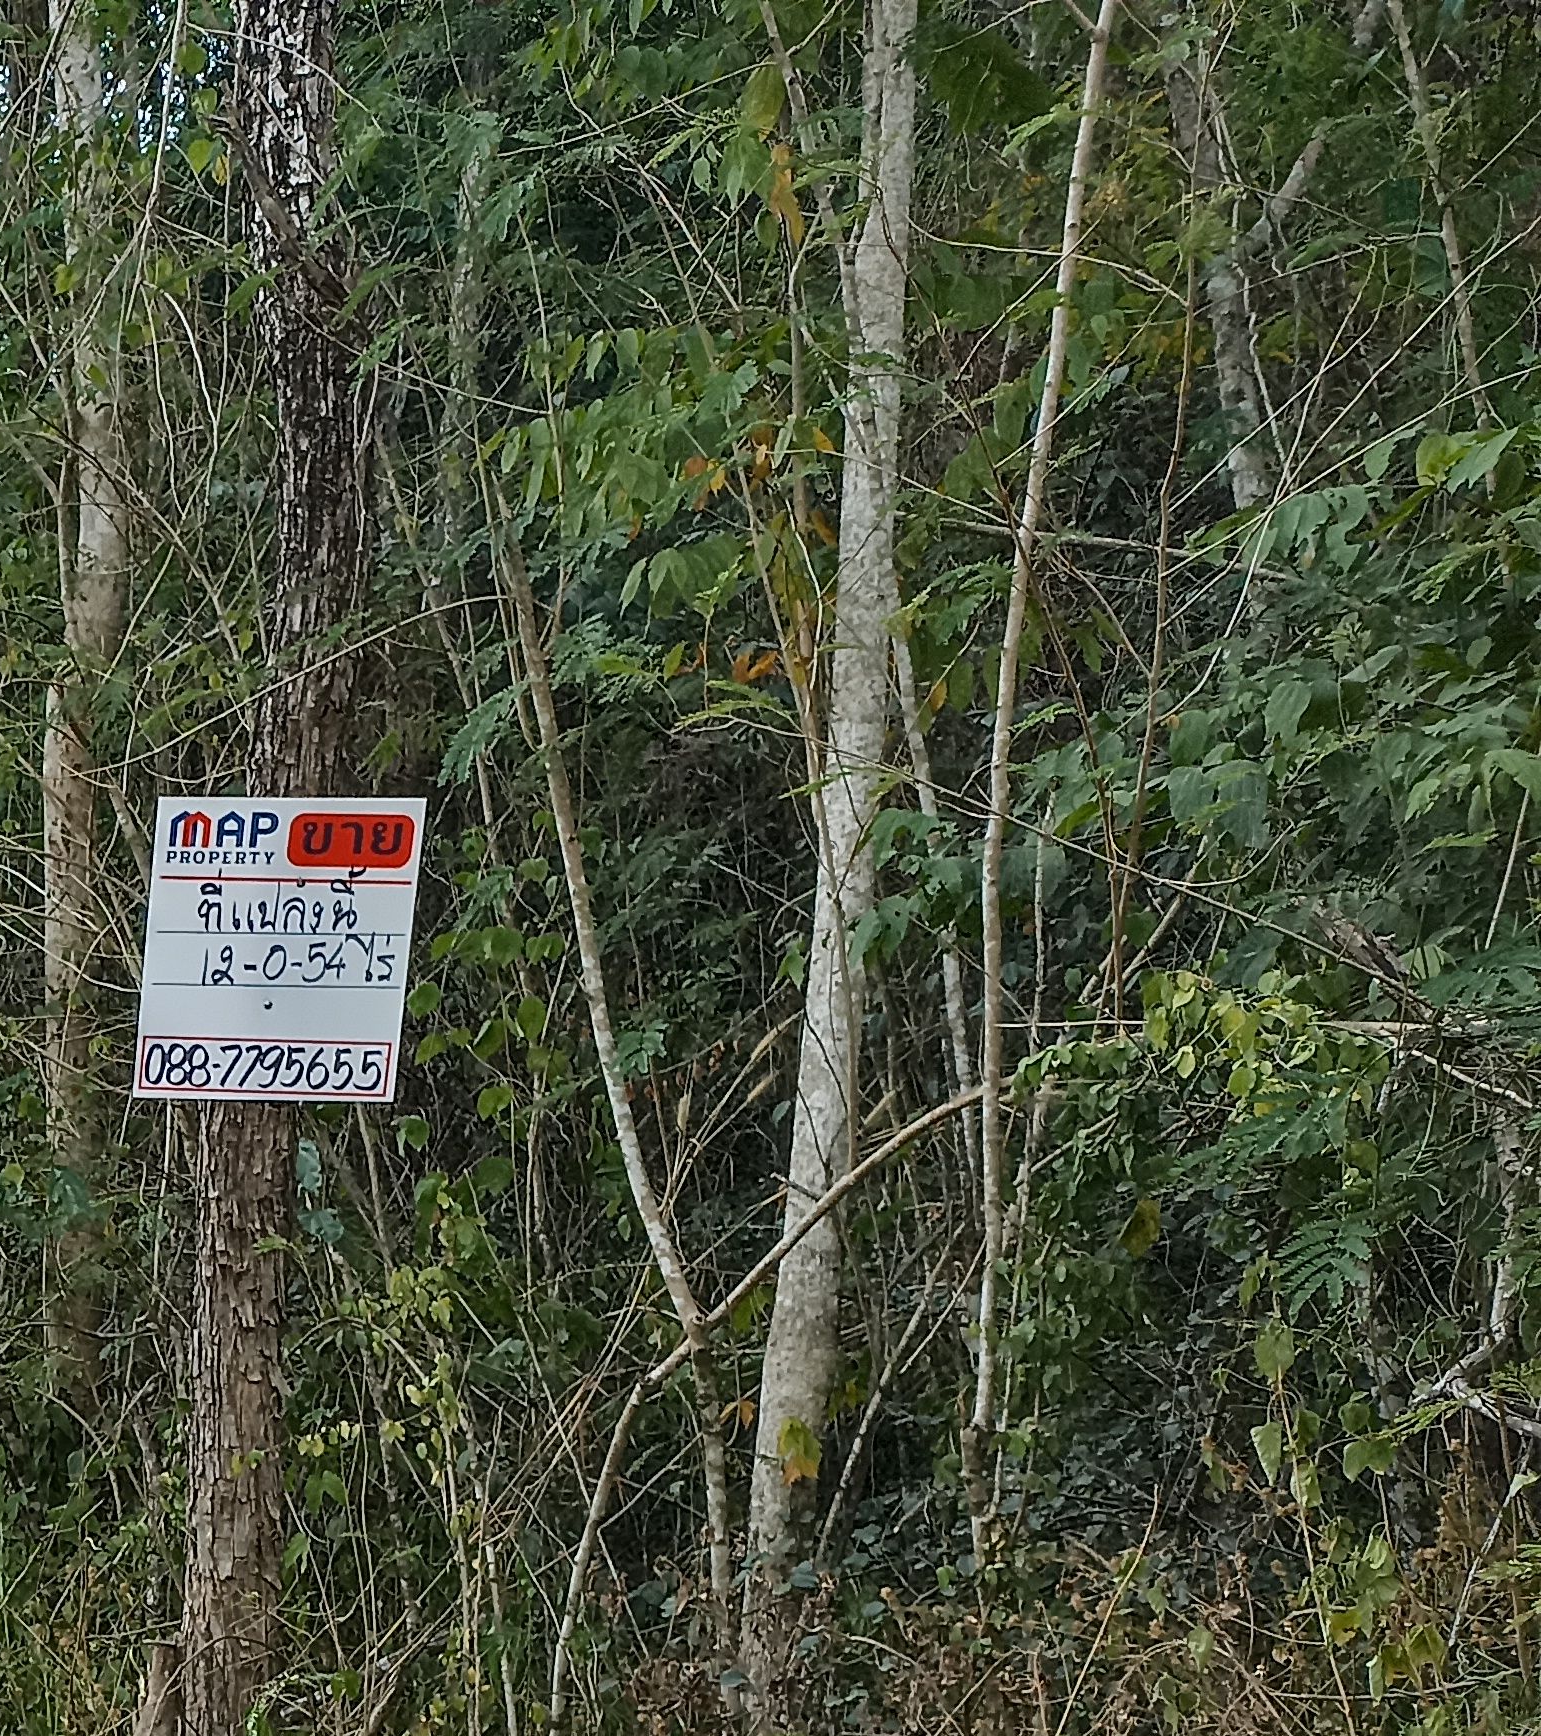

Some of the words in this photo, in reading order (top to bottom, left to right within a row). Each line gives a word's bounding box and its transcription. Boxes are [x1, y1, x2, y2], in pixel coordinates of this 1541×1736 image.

[169, 811, 279, 848] MAP
[302, 822, 404, 856] ขาย
[166, 851, 276, 865] PROPERTY
